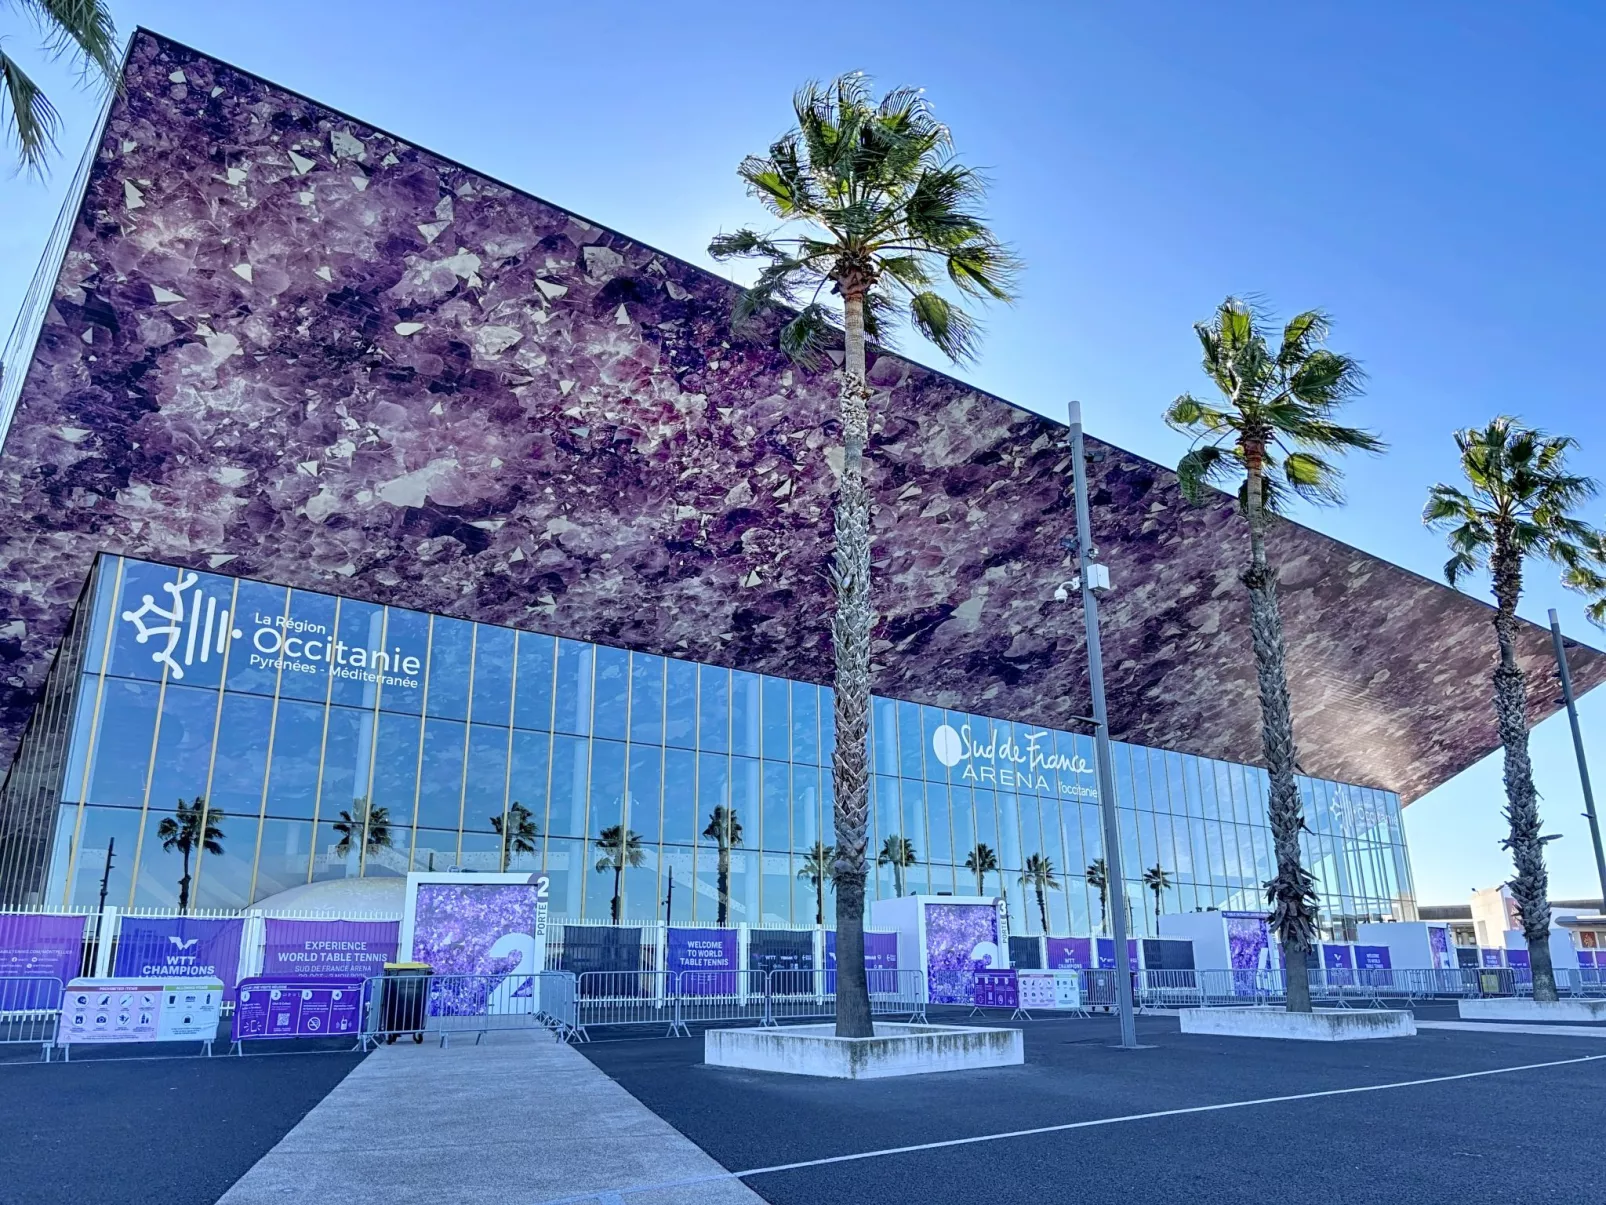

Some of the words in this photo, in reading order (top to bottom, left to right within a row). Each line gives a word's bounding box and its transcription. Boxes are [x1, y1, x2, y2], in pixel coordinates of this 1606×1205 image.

[254, 612, 271, 625] La
[276, 616, 326, 634] Région
[253, 627, 421, 675] Occitanie
[250, 654, 316, 674] Pyrénées
[328, 665, 418, 688] Méditerranée
[960, 724, 998, 766] Sud
[999, 737, 1026, 762] de
[1024, 731, 1094, 774] France
[962, 764, 1050, 791] ARENA
[537, 876, 549, 898] 2
[998, 900, 1007, 915] 3
[537, 904, 547, 936] PORTE
[304, 941, 367, 951] EXPERIENCE
[687, 941, 723, 949] WELCOME
[278, 952, 318, 962] WORLD
[320, 952, 352, 962] TABLE
[354, 953, 388, 962] TENNIS
[687, 949, 697, 957] TO
[166, 955, 197, 965] WTT
[680, 957, 702, 966] TABLE
[142, 965, 216, 975] CHAMPIONS
[295, 965, 310, 973] SUD
